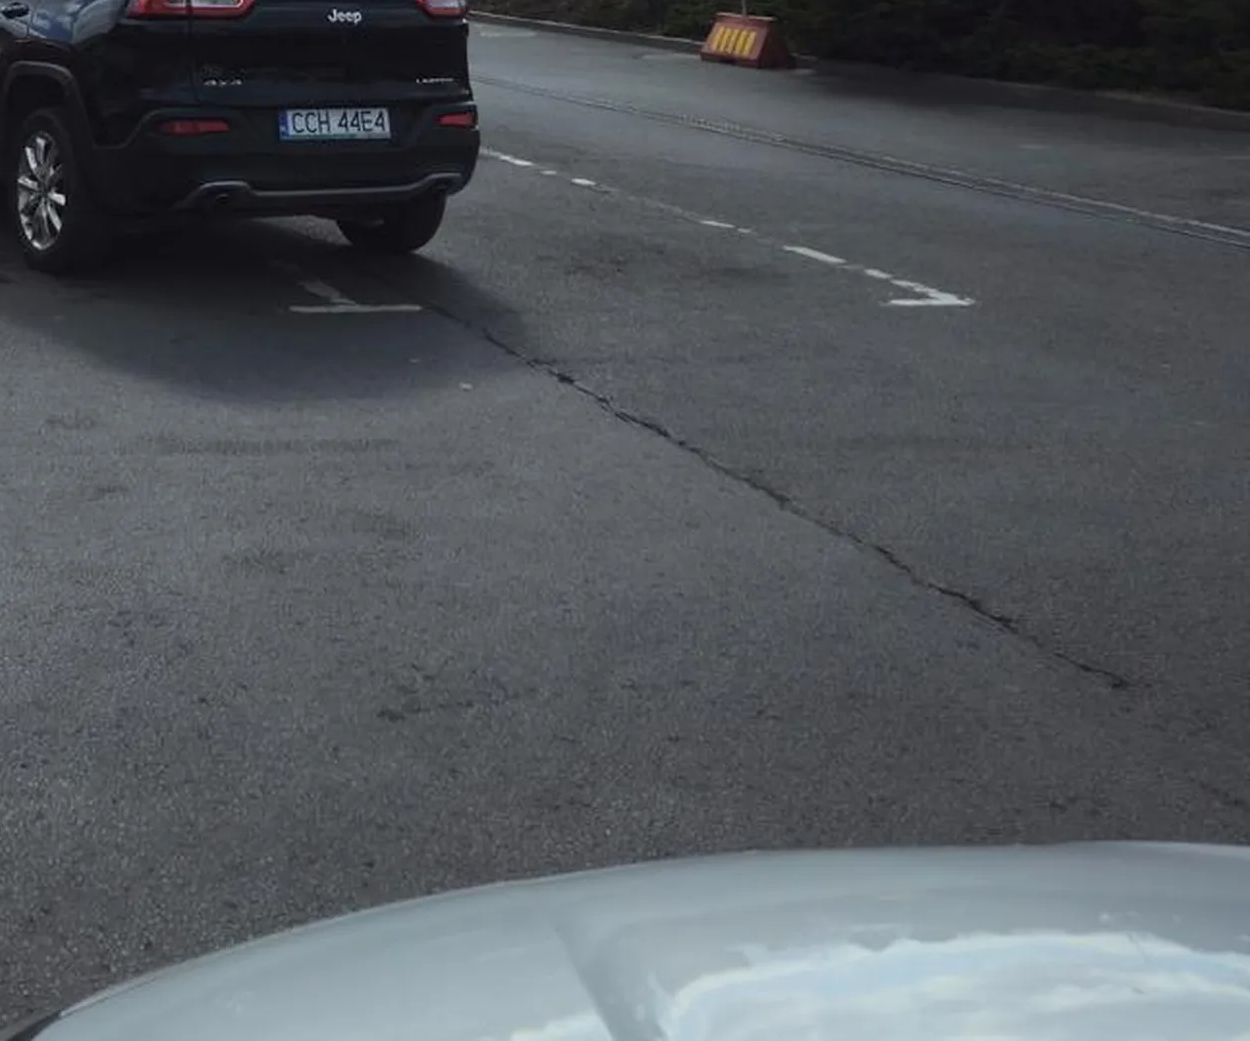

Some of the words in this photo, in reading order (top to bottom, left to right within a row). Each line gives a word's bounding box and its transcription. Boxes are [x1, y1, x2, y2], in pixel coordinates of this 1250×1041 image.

[327, 9, 362, 24] Jeep
[292, 112, 329, 133] CCH
[337, 111, 387, 133] 44E4
